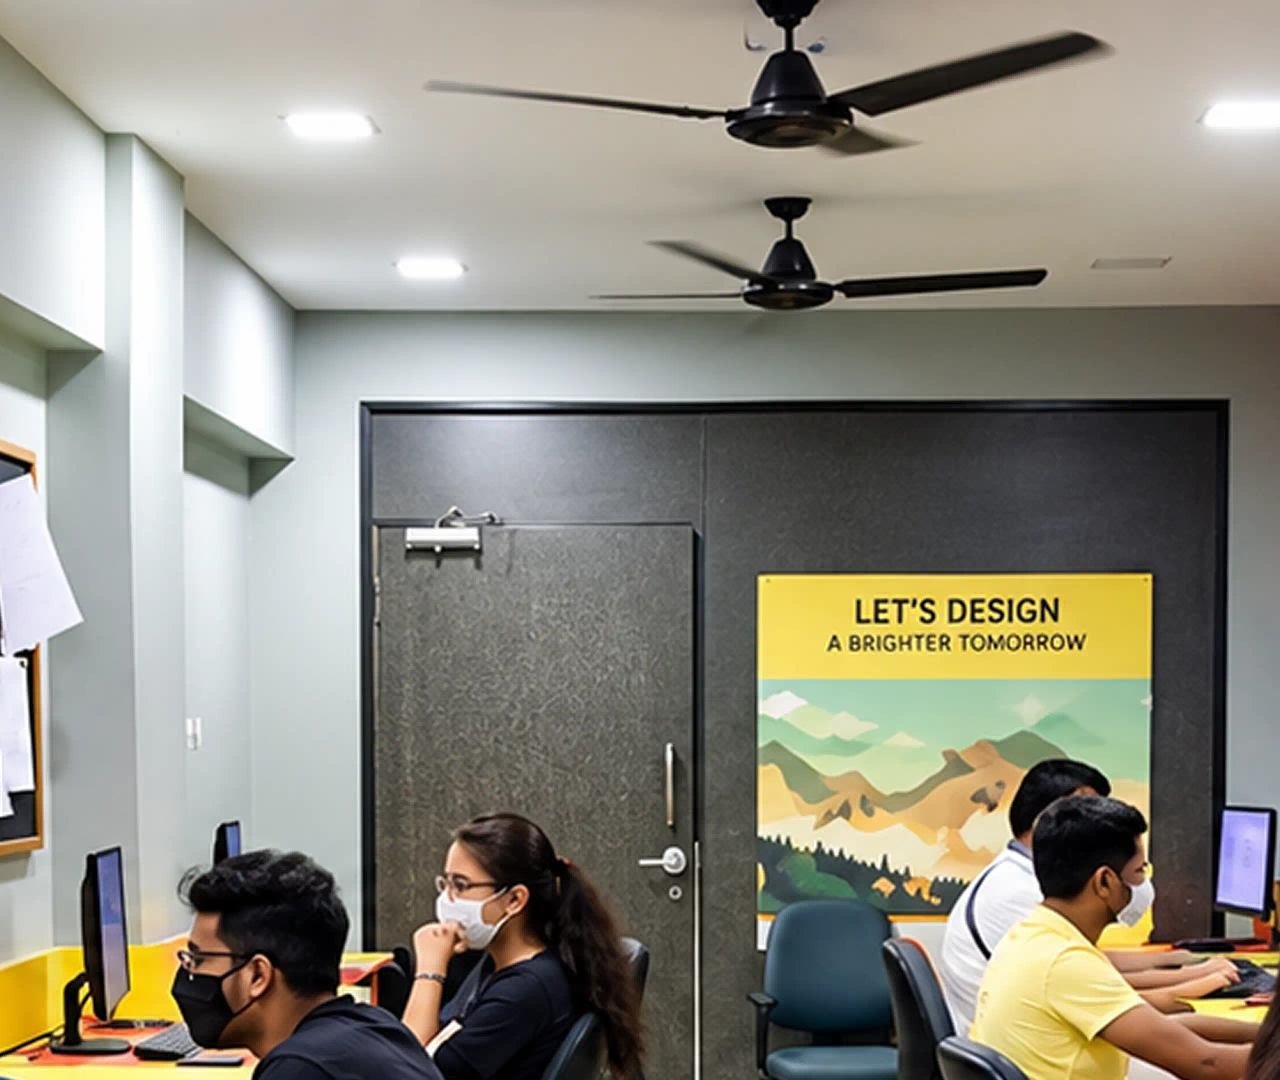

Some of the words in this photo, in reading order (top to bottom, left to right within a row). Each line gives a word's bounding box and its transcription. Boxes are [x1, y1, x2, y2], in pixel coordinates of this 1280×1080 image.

[855, 598, 937, 625] LET'S
[948, 597, 1061, 625] DESIGN
[827, 634, 842, 652] A
[849, 634, 951, 652] BRIGHTER
[959, 634, 1087, 652] TOMORROW
